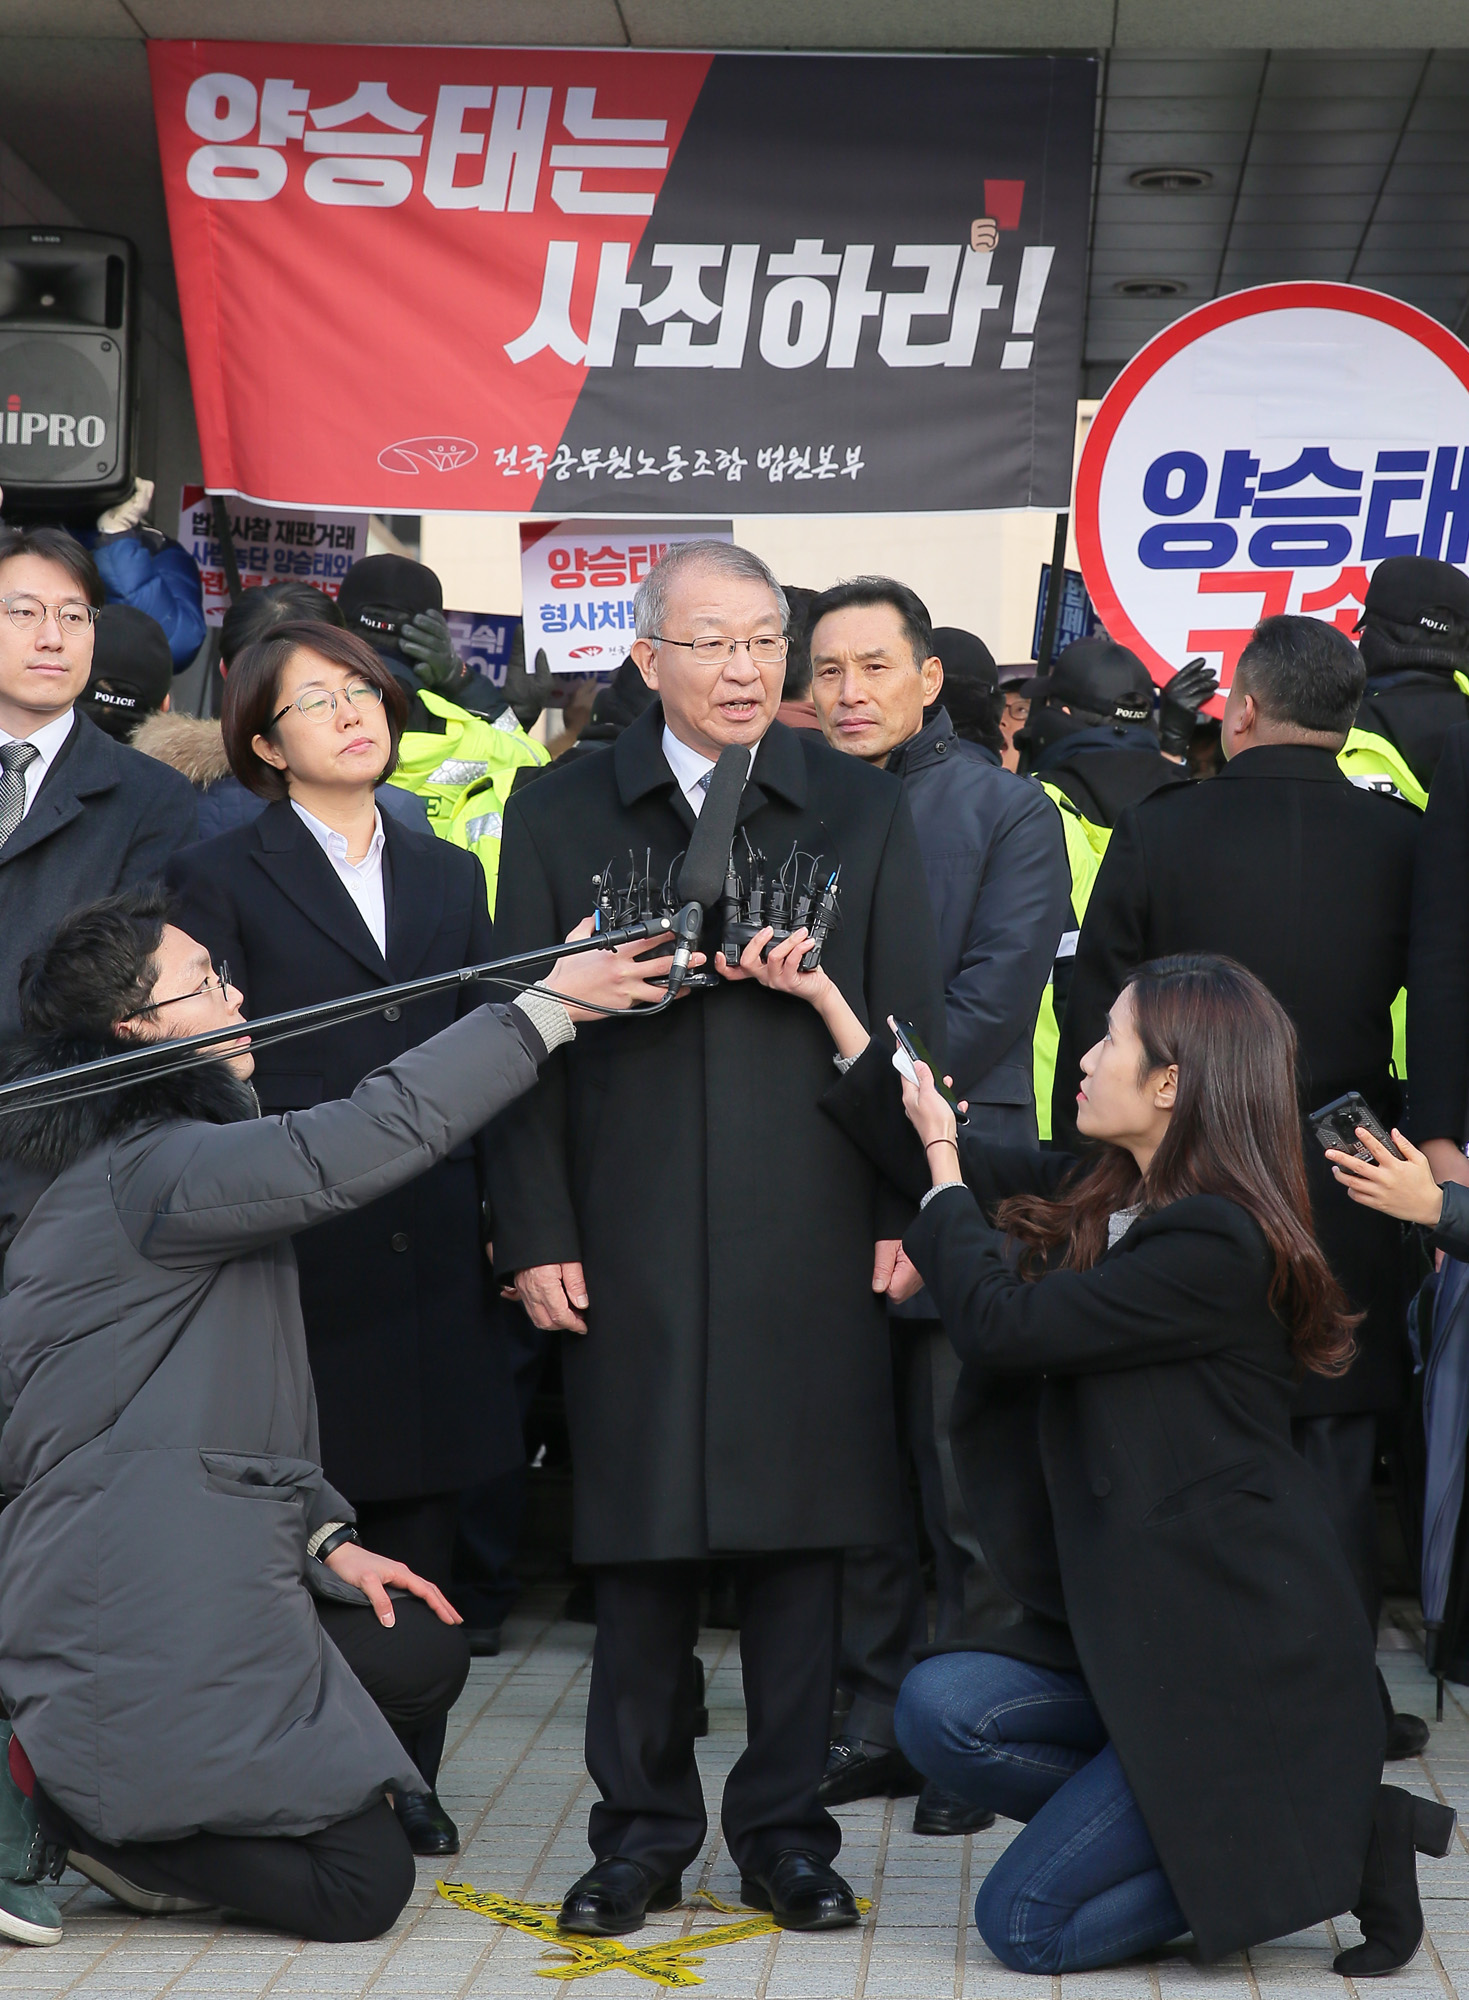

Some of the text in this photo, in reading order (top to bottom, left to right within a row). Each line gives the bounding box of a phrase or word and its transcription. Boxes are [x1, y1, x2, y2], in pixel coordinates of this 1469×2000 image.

[185, 72, 669, 215] 양승태는
[503, 239, 1056, 370] 사죄하라!
[0, 394, 106, 448] IPRO
[493, 444, 865, 483] 전국공무원노동조합 법원본부
[1138, 446, 1469, 569] 양승태
[192, 512, 356, 551] 법사찰 재판거래
[273, 547, 353, 579] 양승태와
[360, 614, 395, 632] POLICE
[94, 691, 136, 707] POLICE
